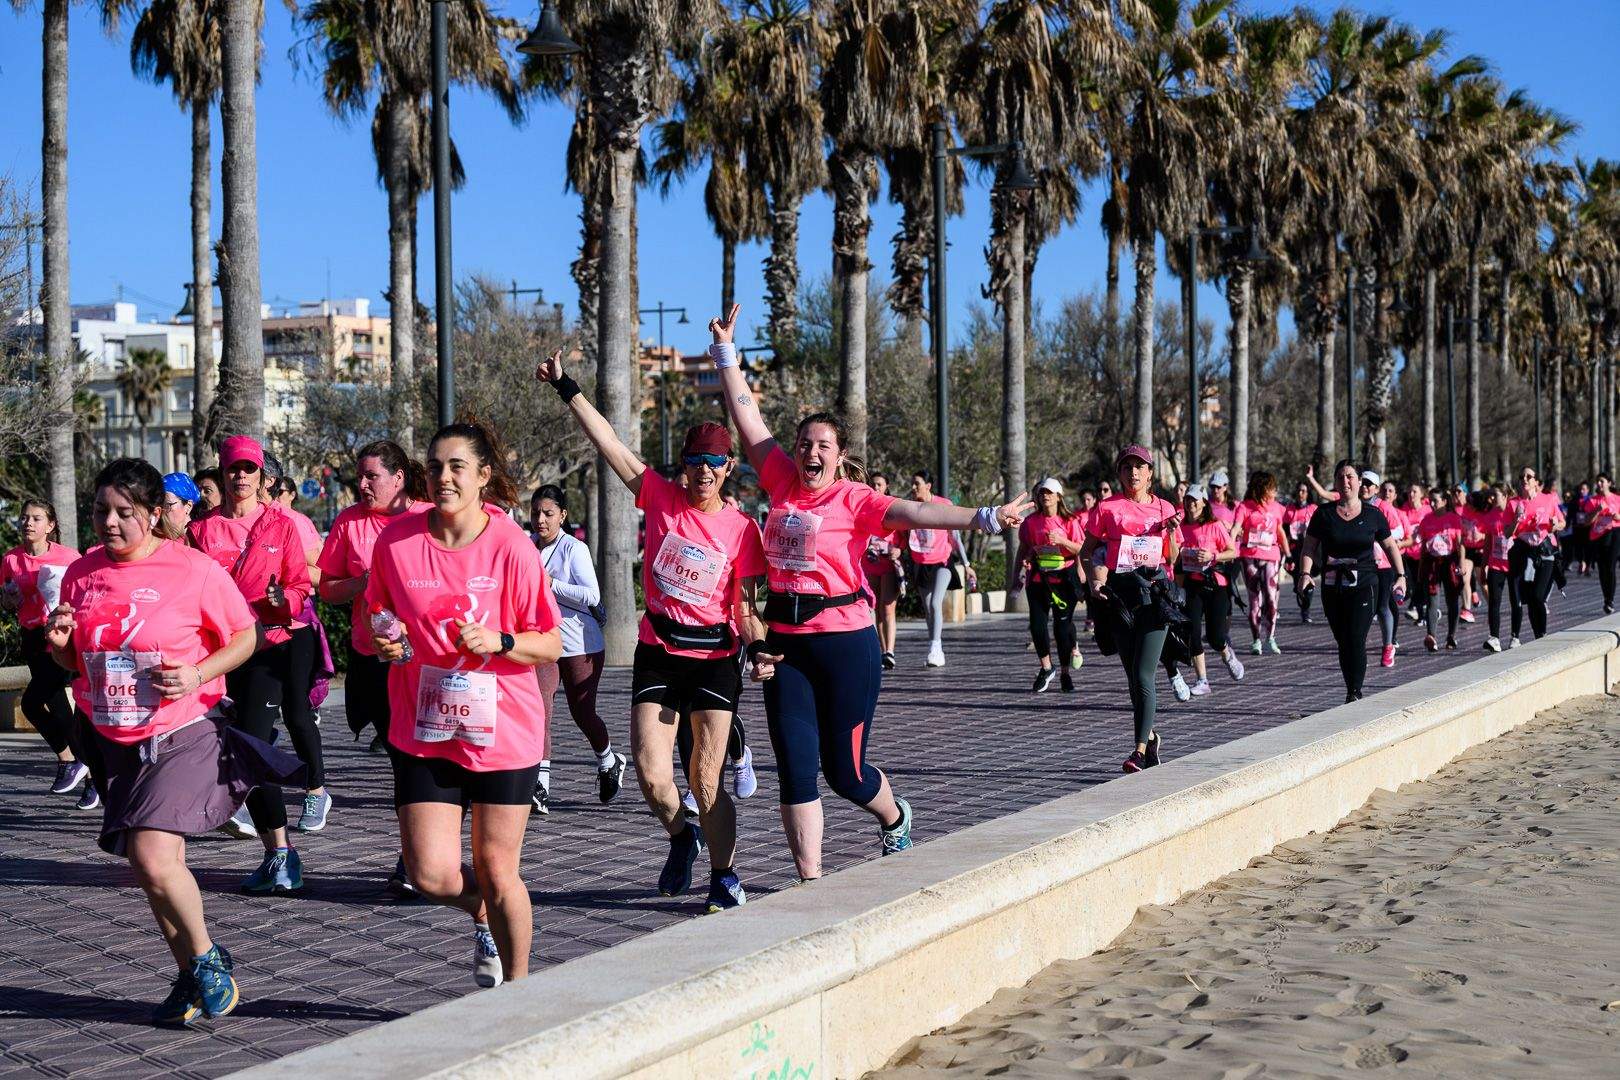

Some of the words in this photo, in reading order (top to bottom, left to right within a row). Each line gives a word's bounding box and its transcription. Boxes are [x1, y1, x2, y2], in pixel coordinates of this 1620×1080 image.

[779, 536, 798, 547] 016
[1132, 553, 1149, 561] 016
[676, 565, 699, 581] 016
[108, 684, 138, 697] 016
[440, 703, 470, 717] 016
